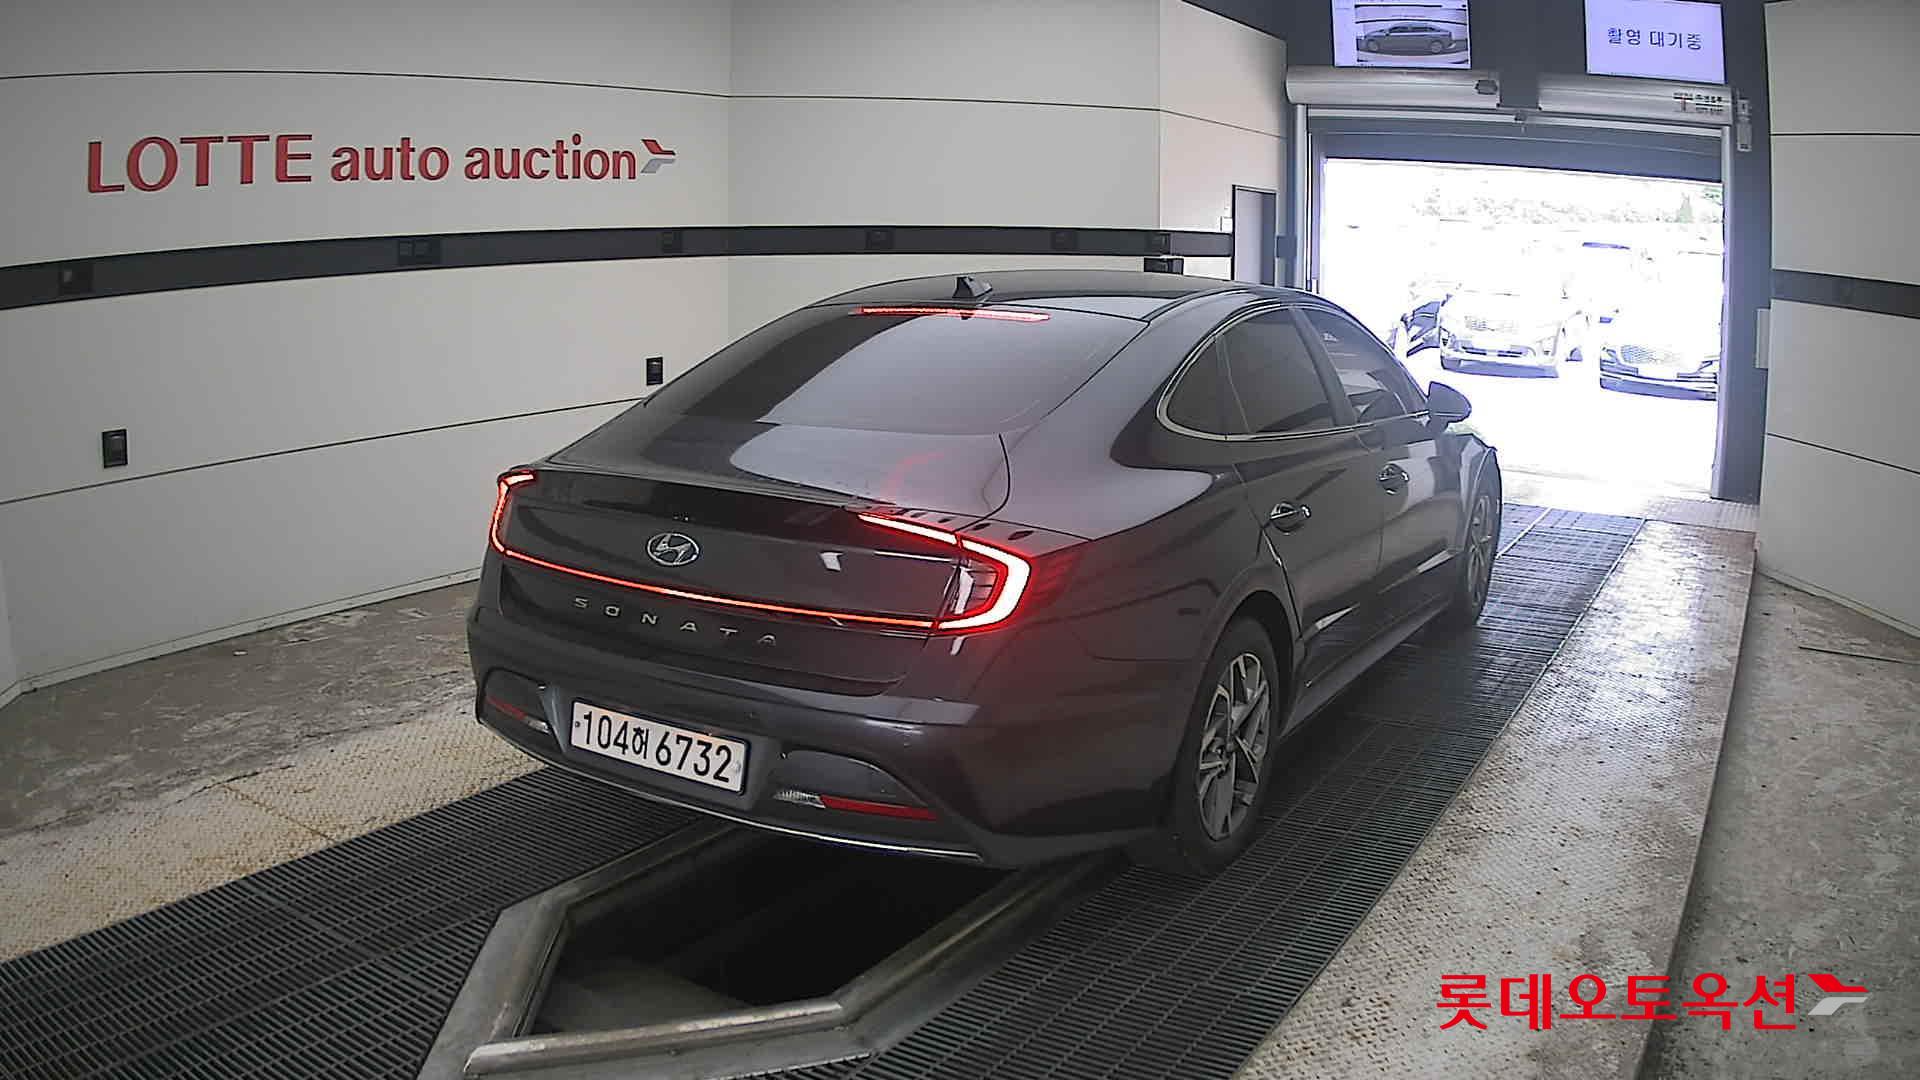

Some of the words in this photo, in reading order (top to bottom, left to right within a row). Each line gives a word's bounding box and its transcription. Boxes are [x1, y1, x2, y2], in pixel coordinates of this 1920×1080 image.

[87, 134, 313, 194] LOTTE
[330, 136, 450, 183] auto
[463, 133, 638, 181] auction
[574, 597, 777, 646] SONATA
